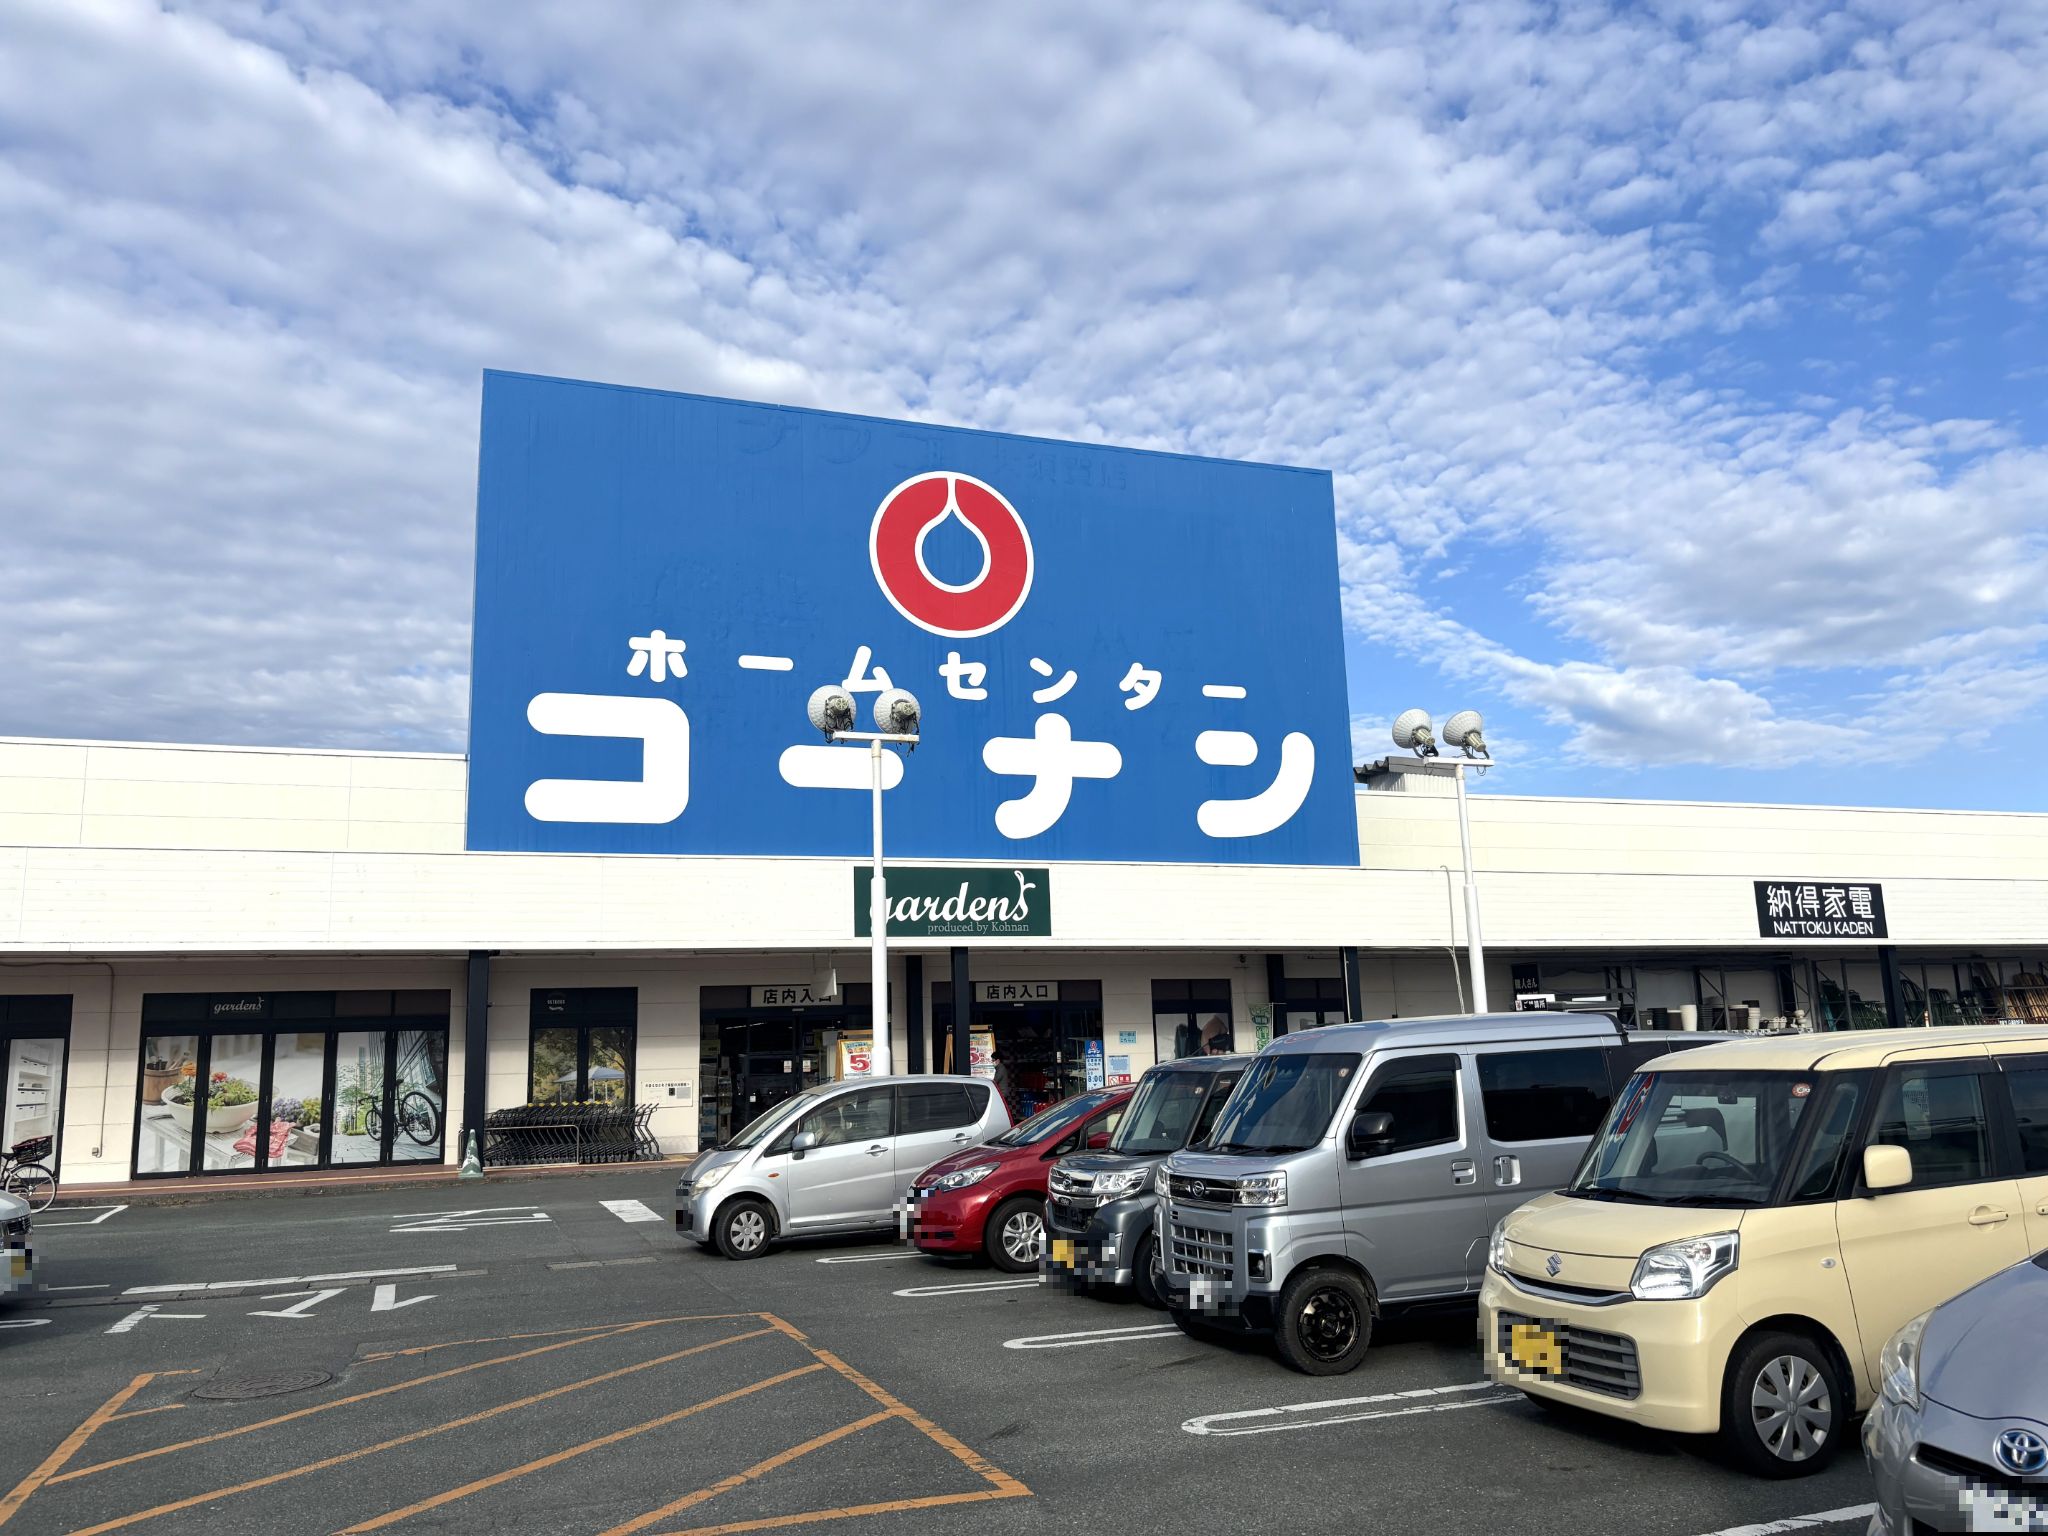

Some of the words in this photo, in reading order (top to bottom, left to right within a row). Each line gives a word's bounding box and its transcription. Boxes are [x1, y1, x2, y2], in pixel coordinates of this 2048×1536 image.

[627, 630, 1247, 711] ホームセンター
[525, 693, 1315, 839] コーナン
[1766, 885, 1876, 919] 納得家電
[928, 922, 974, 935] produced
[977, 922, 988, 935] by
[991, 921, 1029, 932] Kohnan
[1773, 921, 1831, 935] NATTOKU
[1833, 922, 1874, 935] KADEN
[986, 984, 1048, 999] 店内入口
[213, 996, 265, 1014] gardens
